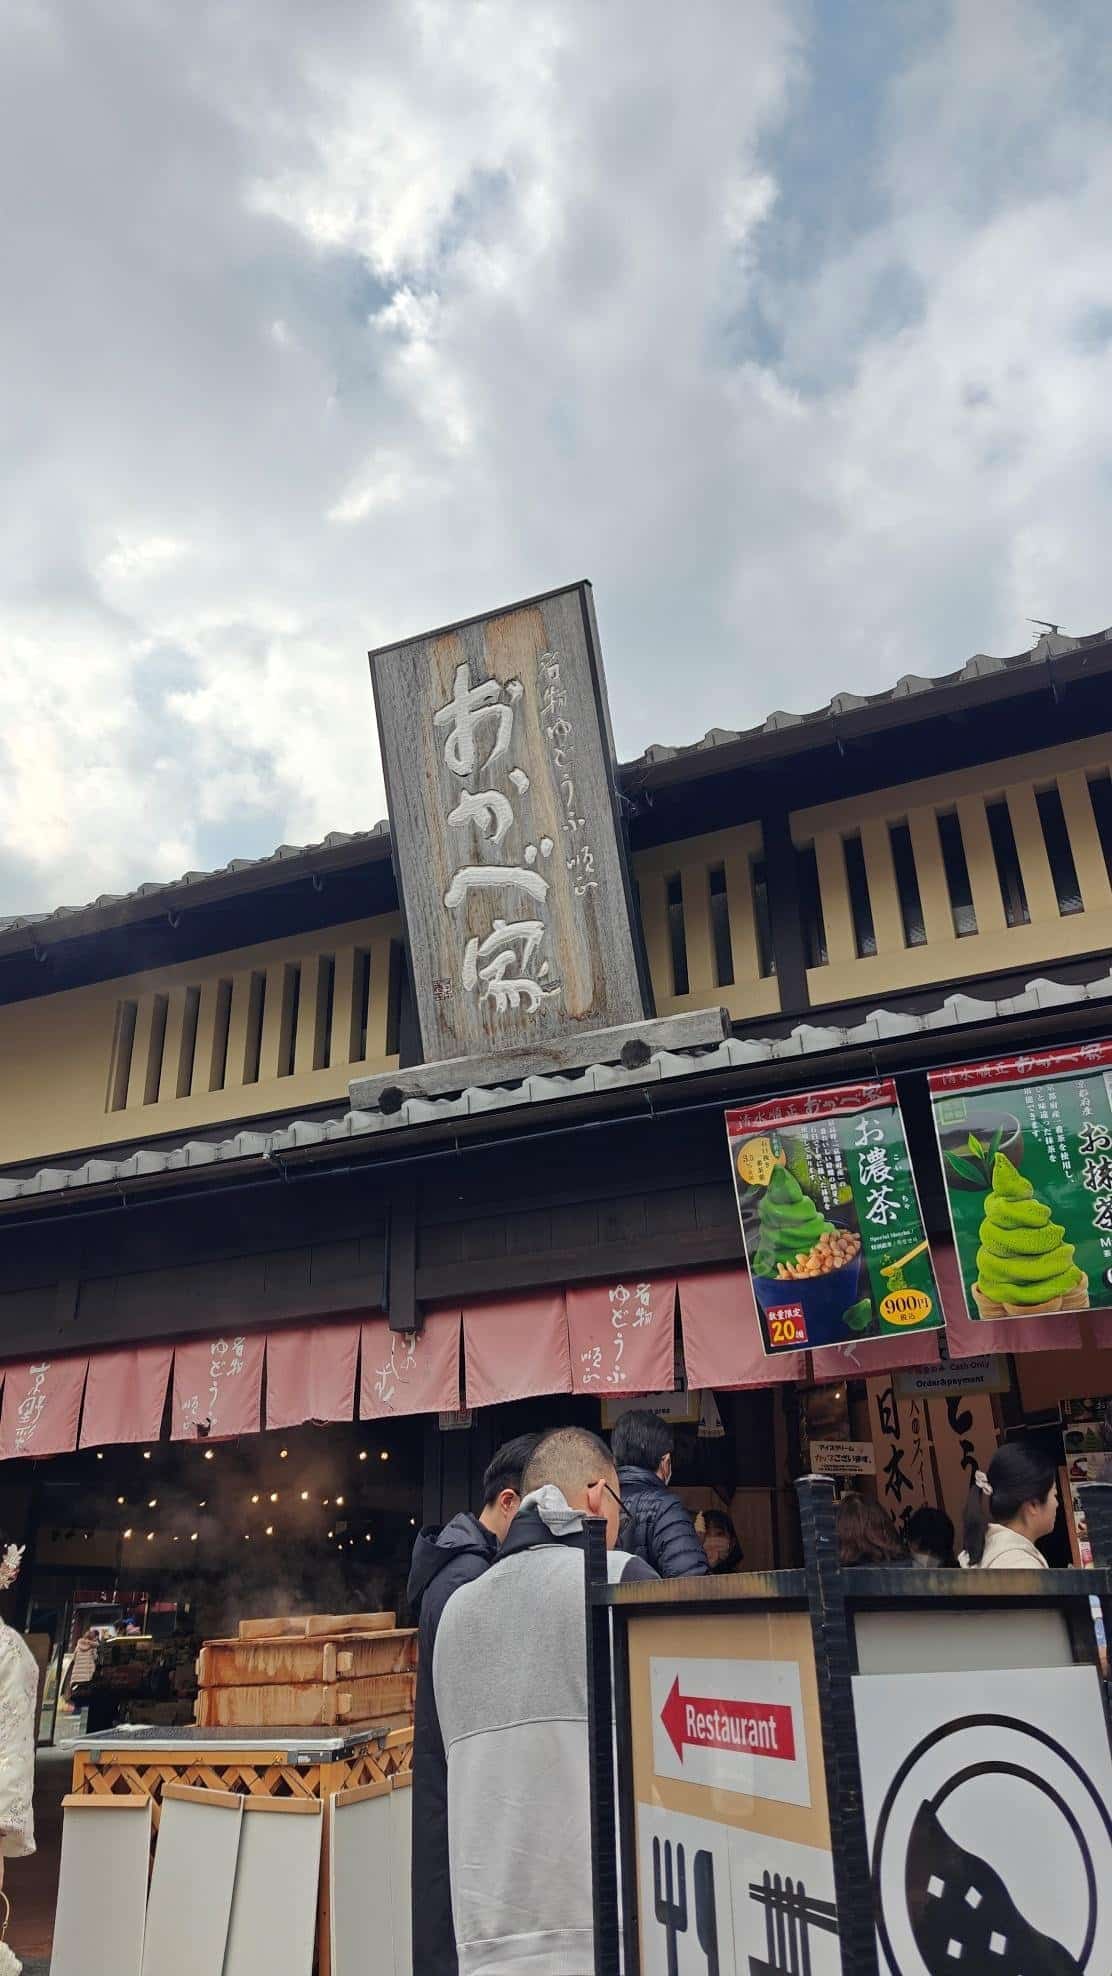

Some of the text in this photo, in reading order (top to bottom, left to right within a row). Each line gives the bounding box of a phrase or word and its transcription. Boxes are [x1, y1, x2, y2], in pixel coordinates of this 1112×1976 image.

[854, 1116, 901, 1225] お濃茶
[884, 1295, 929, 1315] 900円
[685, 1703, 778, 1751] Restaurant
